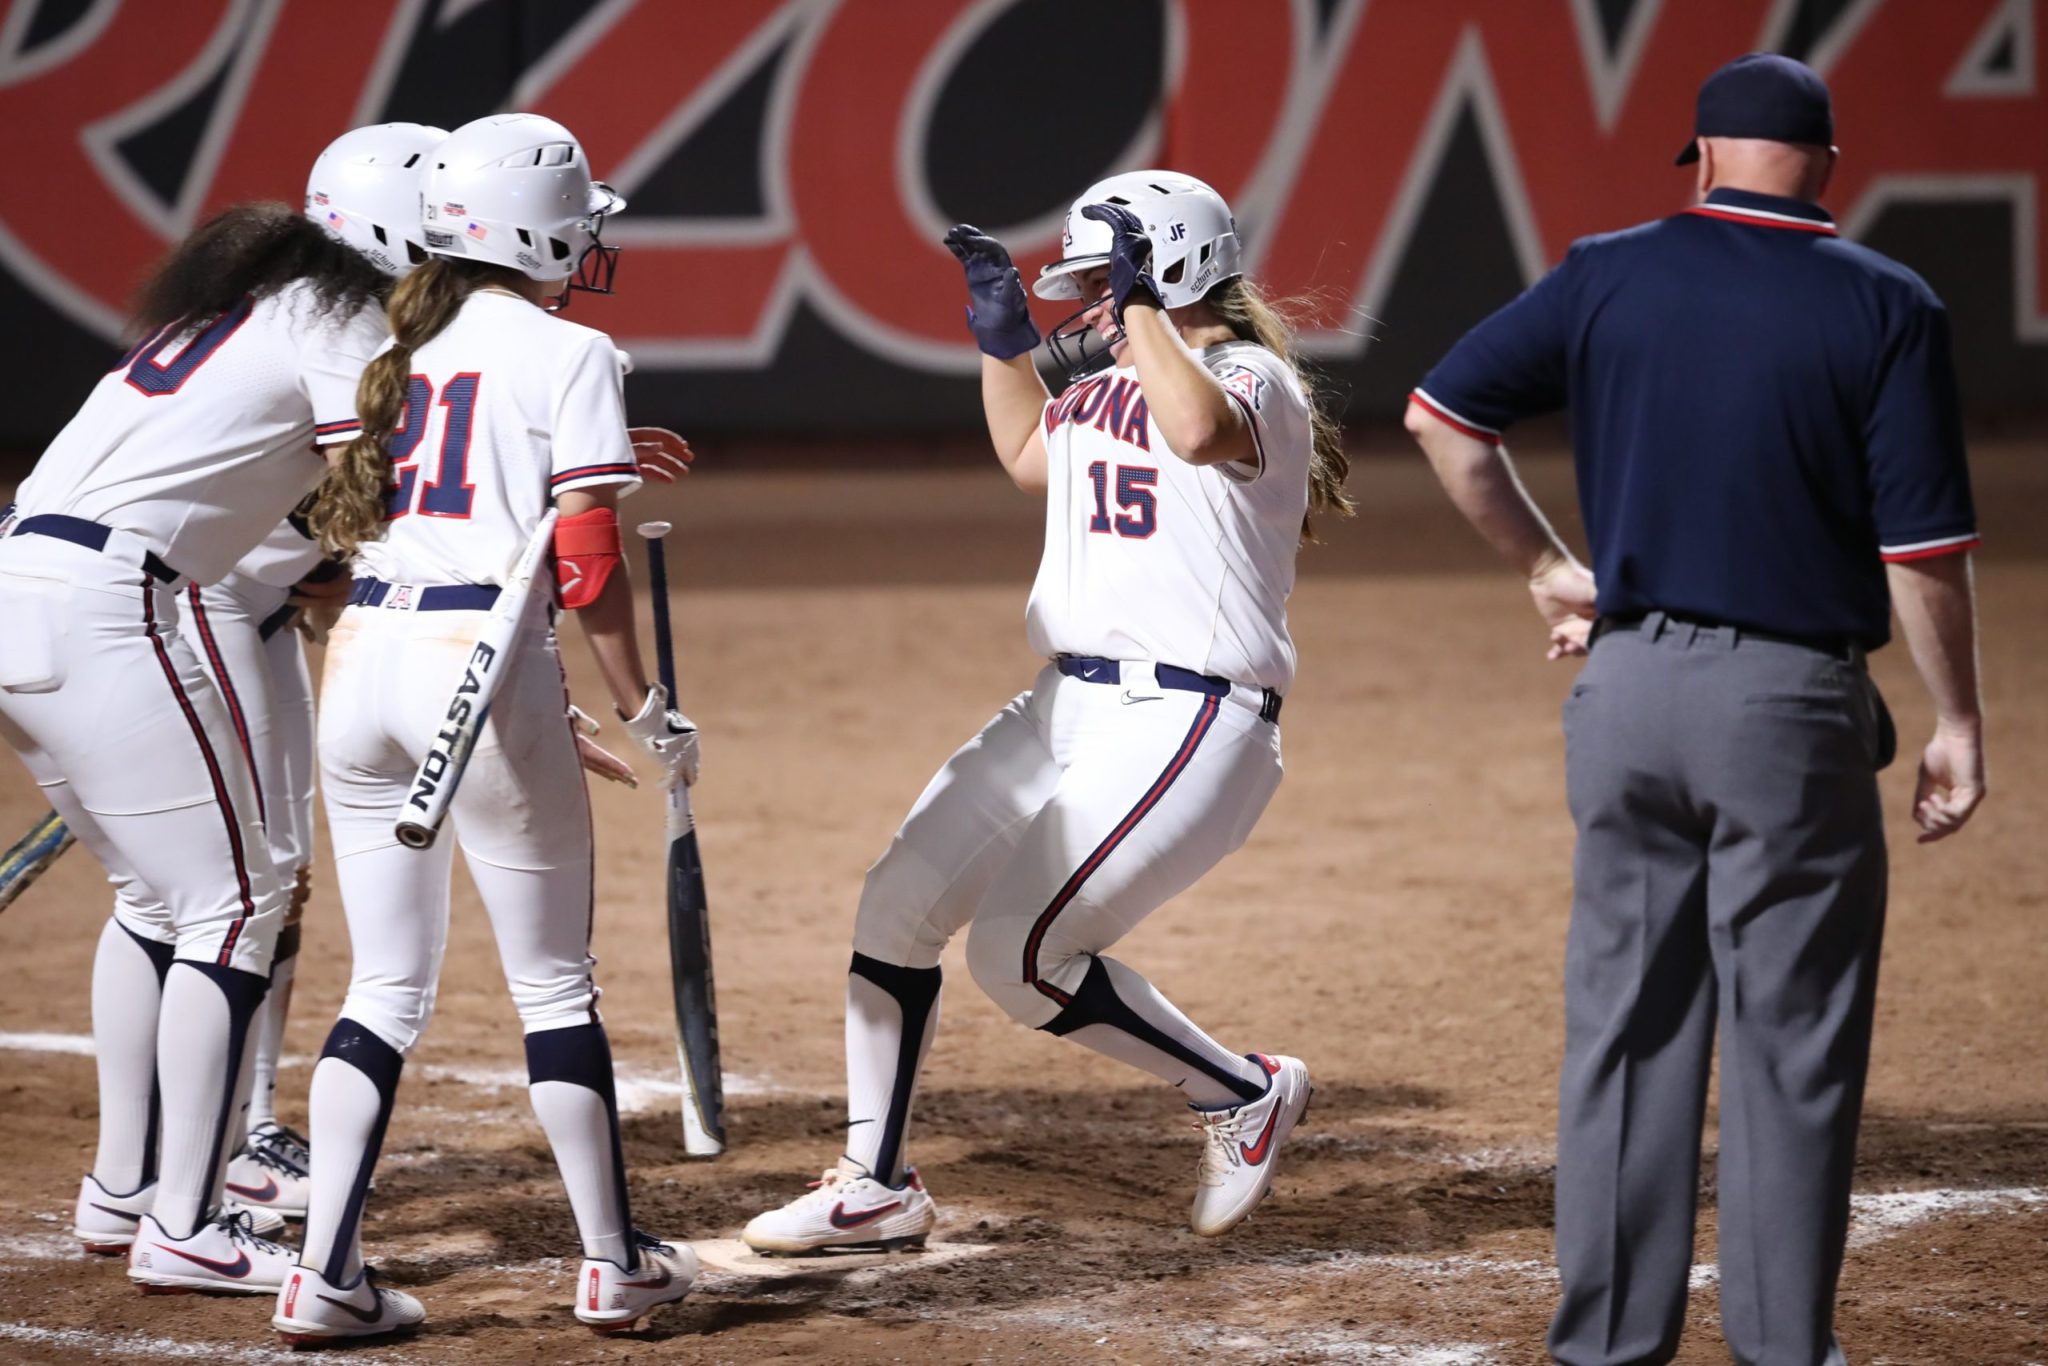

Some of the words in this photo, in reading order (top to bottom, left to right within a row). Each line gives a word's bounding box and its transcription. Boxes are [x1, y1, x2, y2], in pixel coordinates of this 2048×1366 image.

[1168, 222, 1186, 242] JF
[370, 249, 398, 271] schutt
[1190, 267, 1212, 294] schutt
[383, 372, 482, 520] 21
[1088, 460, 1159, 540] 15
[409, 640, 496, 812] EASTON
